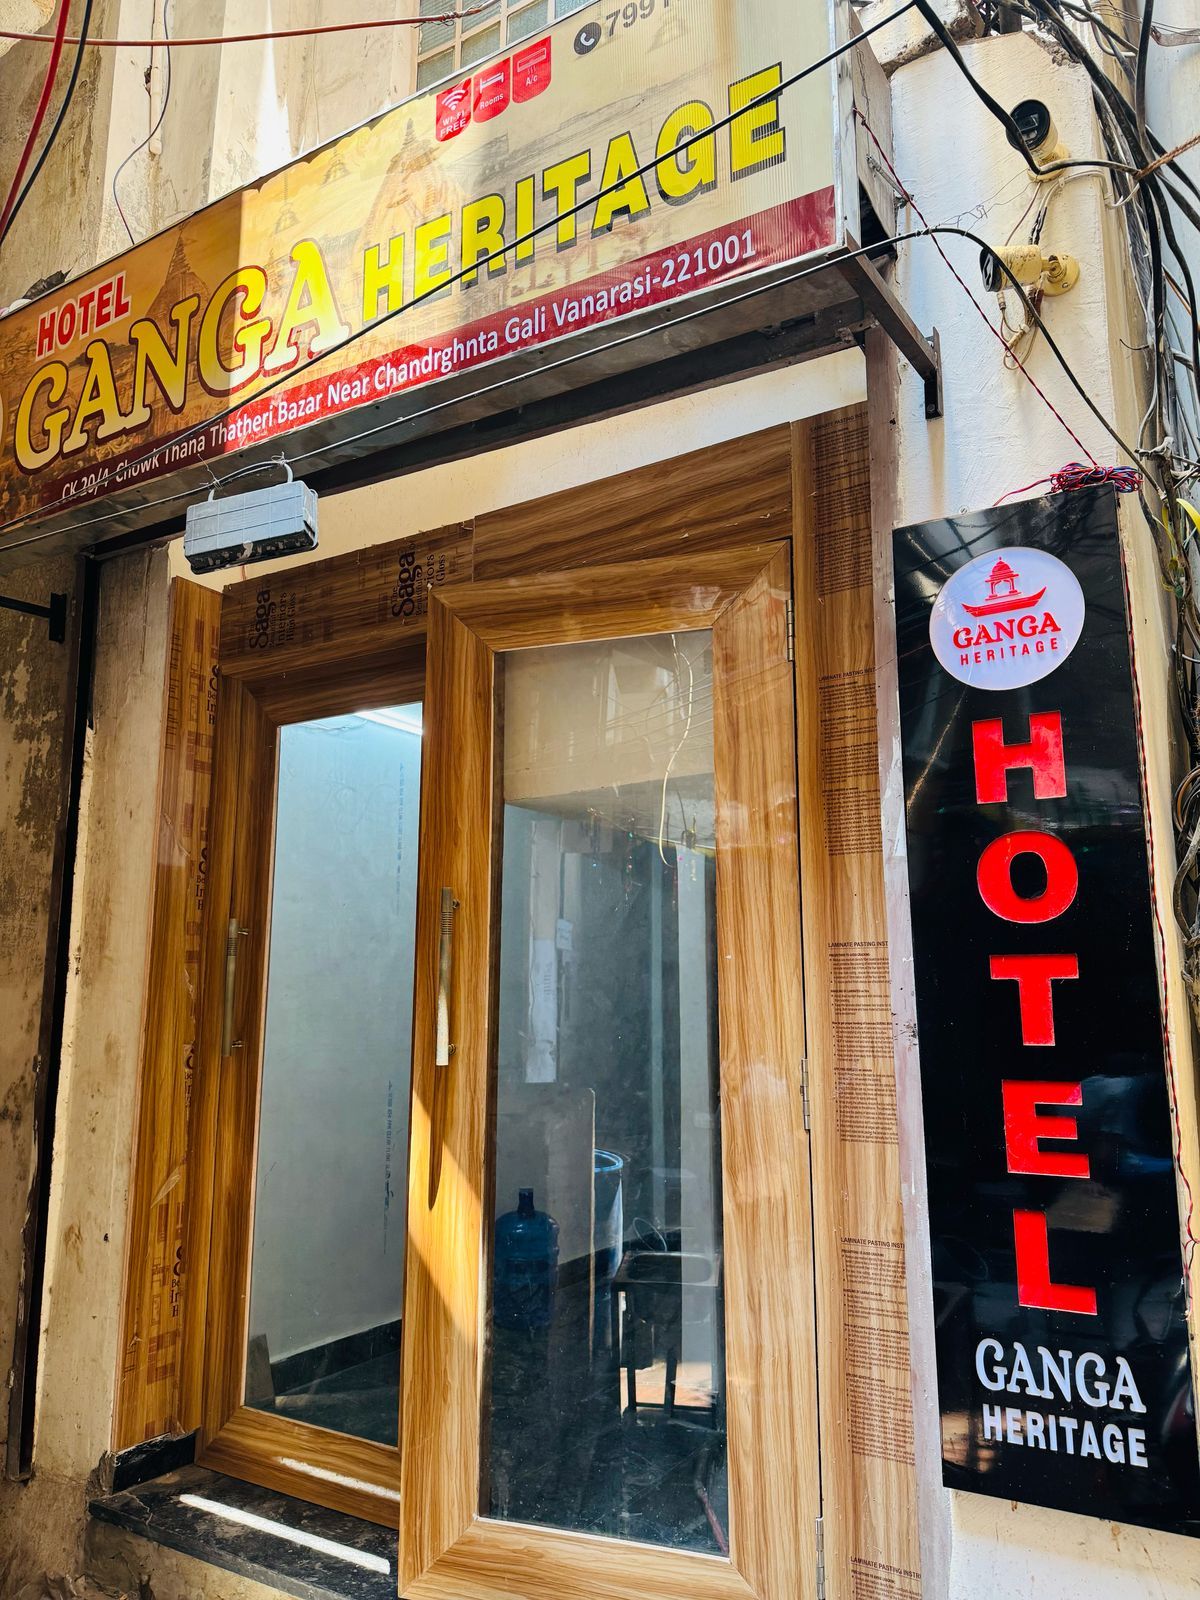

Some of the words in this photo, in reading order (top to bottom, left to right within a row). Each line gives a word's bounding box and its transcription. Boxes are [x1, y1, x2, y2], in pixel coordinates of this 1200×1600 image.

[606, 0, 669, 37] 799
[479, 93, 504, 110] Rooms
[440, 119, 467, 138] FREE
[13, 238, 351, 473] GANGA
[362, 62, 786, 322] HERITAGE
[35, 273, 131, 359] HOTEL
[210, 406, 273, 445] Thatheri
[278, 392, 323, 424] Bazar
[328, 375, 370, 407] Near
[374, 331, 499, 390] Chandrghnta
[504, 305, 546, 344] Gali
[552, 229, 756, 327] Vanarasi-221001
[392, 551, 423, 617] Saga
[435, 554, 446, 582] Gloss
[249, 590, 277, 649] Saga
[952, 612, 1062, 650] GANGA
[960, 637, 1060, 667] HERITAGE
[971, 710, 1097, 1316] HOTEL
[867, 1239, 891, 1248] PASTING
[975, 1337, 1148, 1414] GANGA
[982, 1402, 1149, 1468] HERITAGE
[878, 1562, 902, 1574] PASTING
